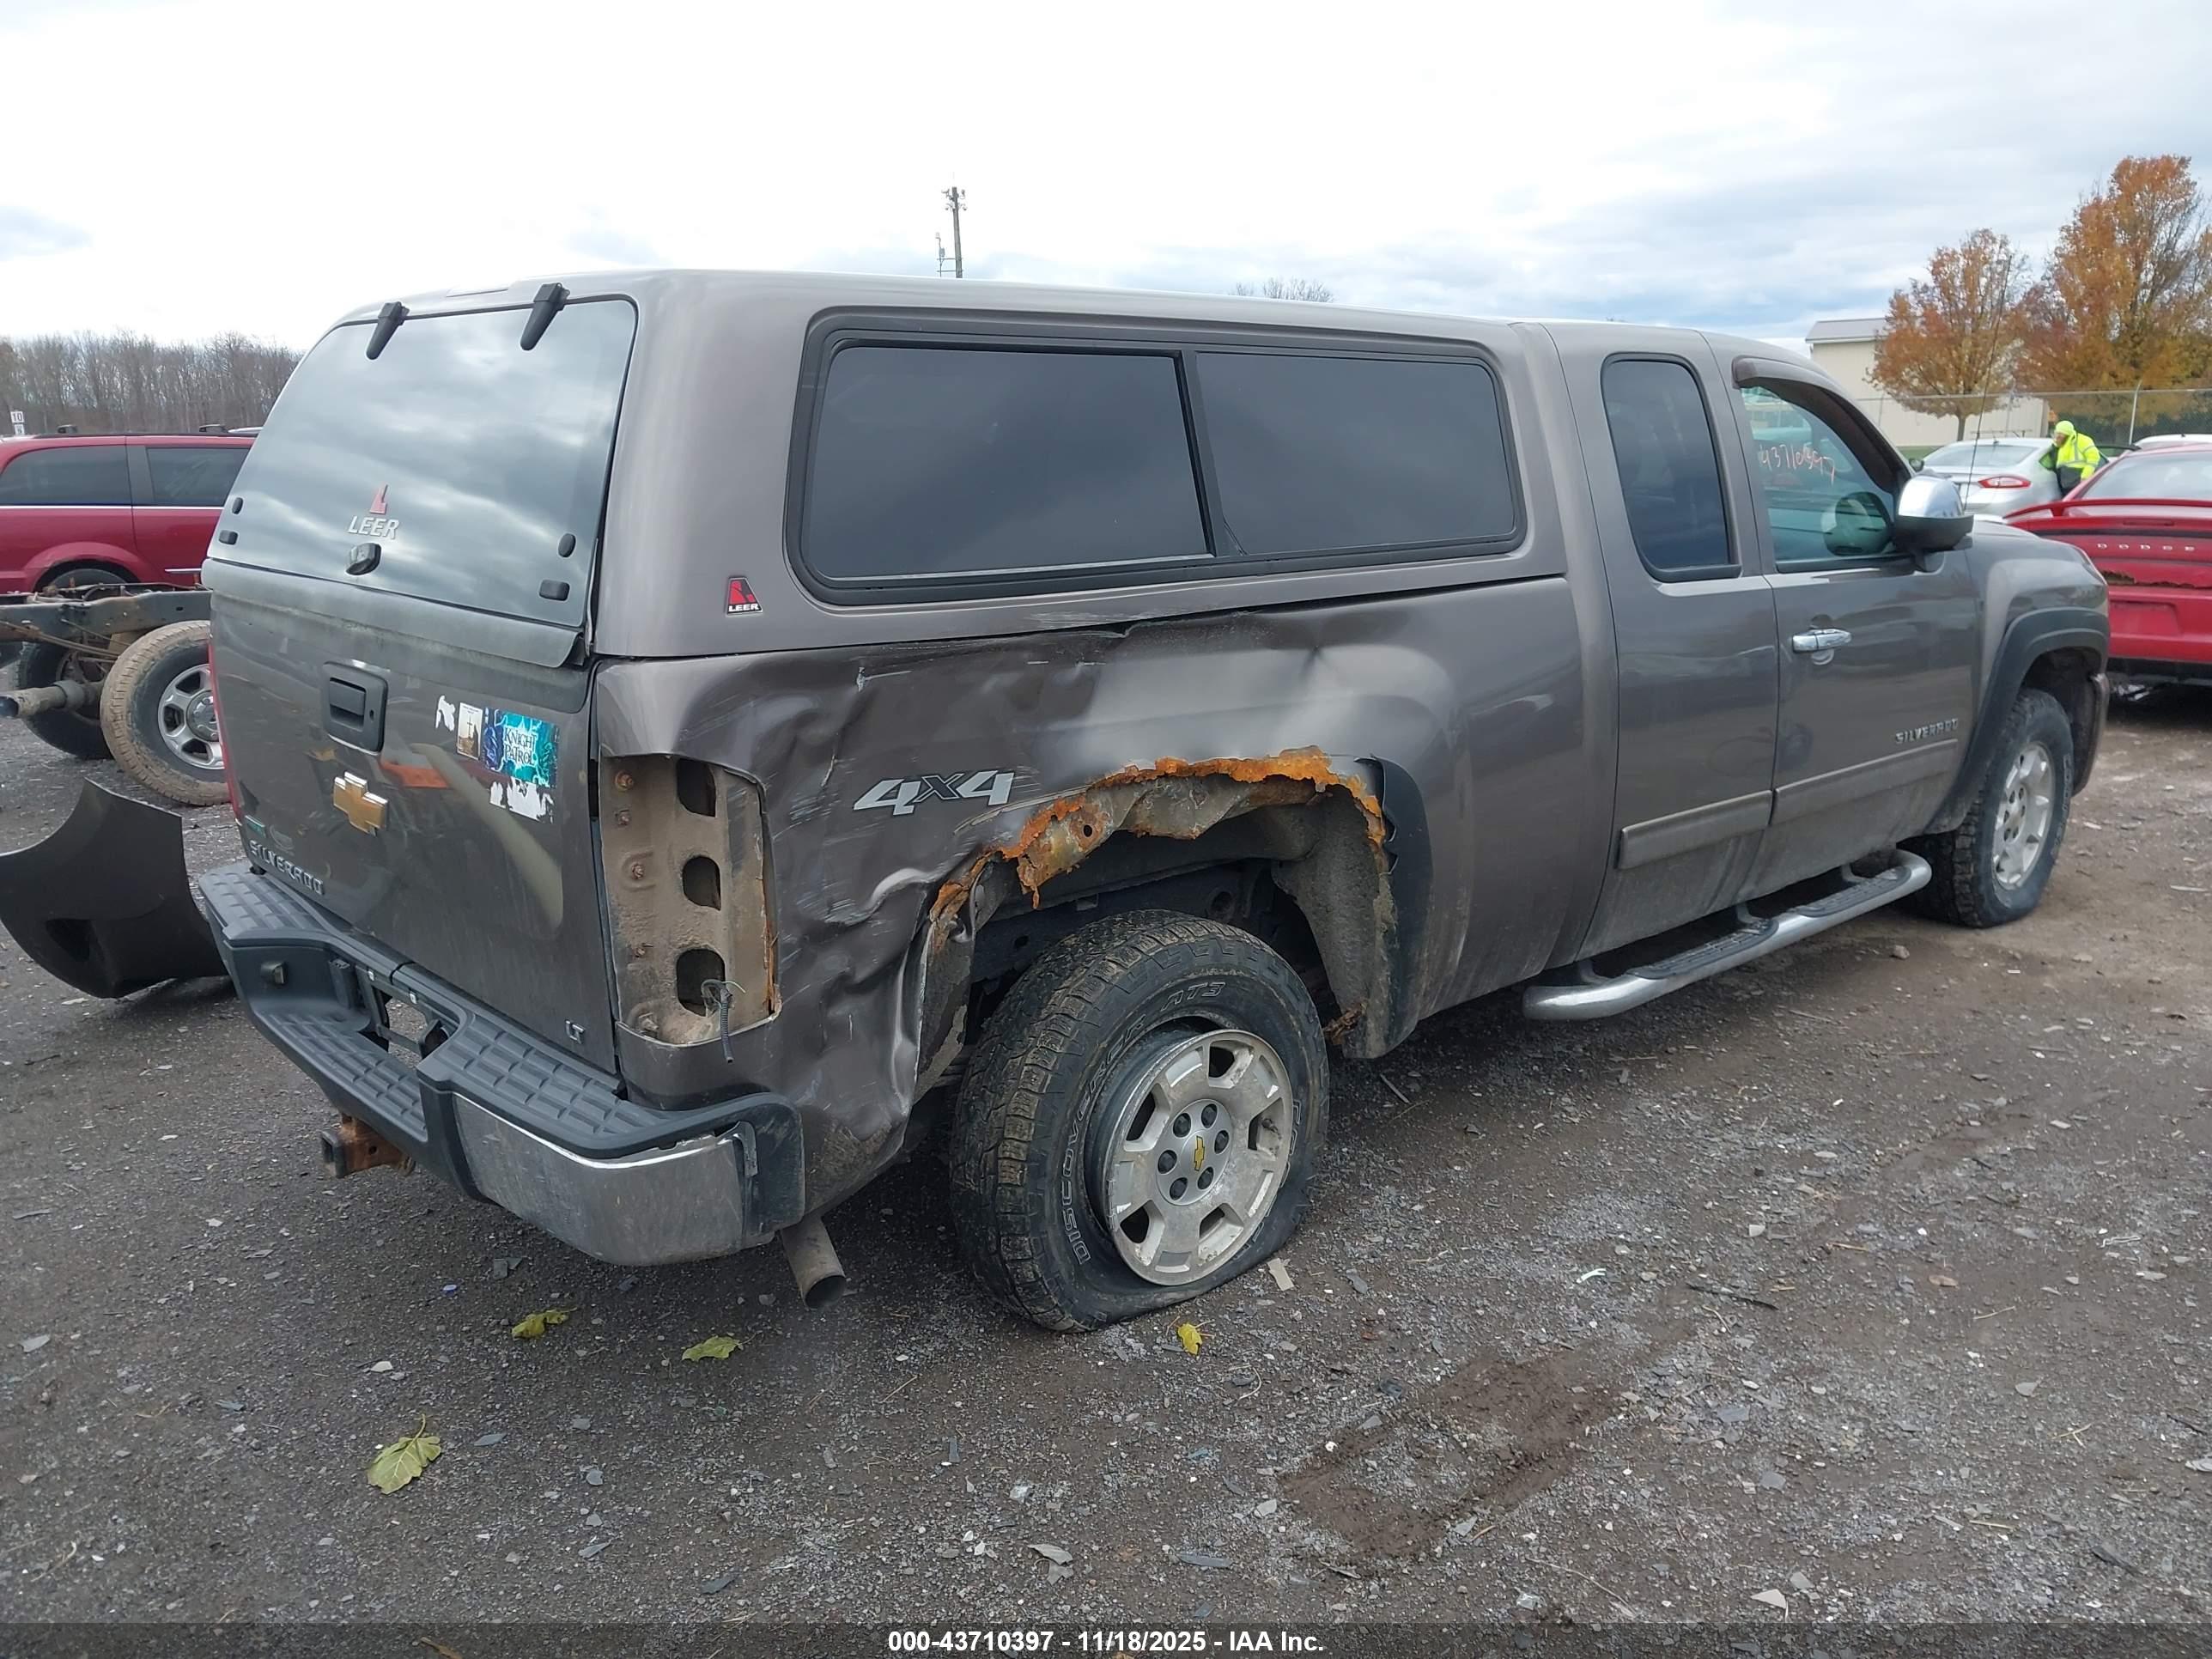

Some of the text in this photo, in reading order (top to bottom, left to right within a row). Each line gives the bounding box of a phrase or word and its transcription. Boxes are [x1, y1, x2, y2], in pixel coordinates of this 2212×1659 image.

[348, 515, 399, 540] LEER
[2097, 543, 2196, 552] DODGE
[728, 603, 759, 612] LEER
[504, 743, 535, 766] PATROL
[249, 839, 325, 896] SILVERADO
[1160, 981, 1225, 1012] AT3
[565, 1020, 585, 1045] LT
